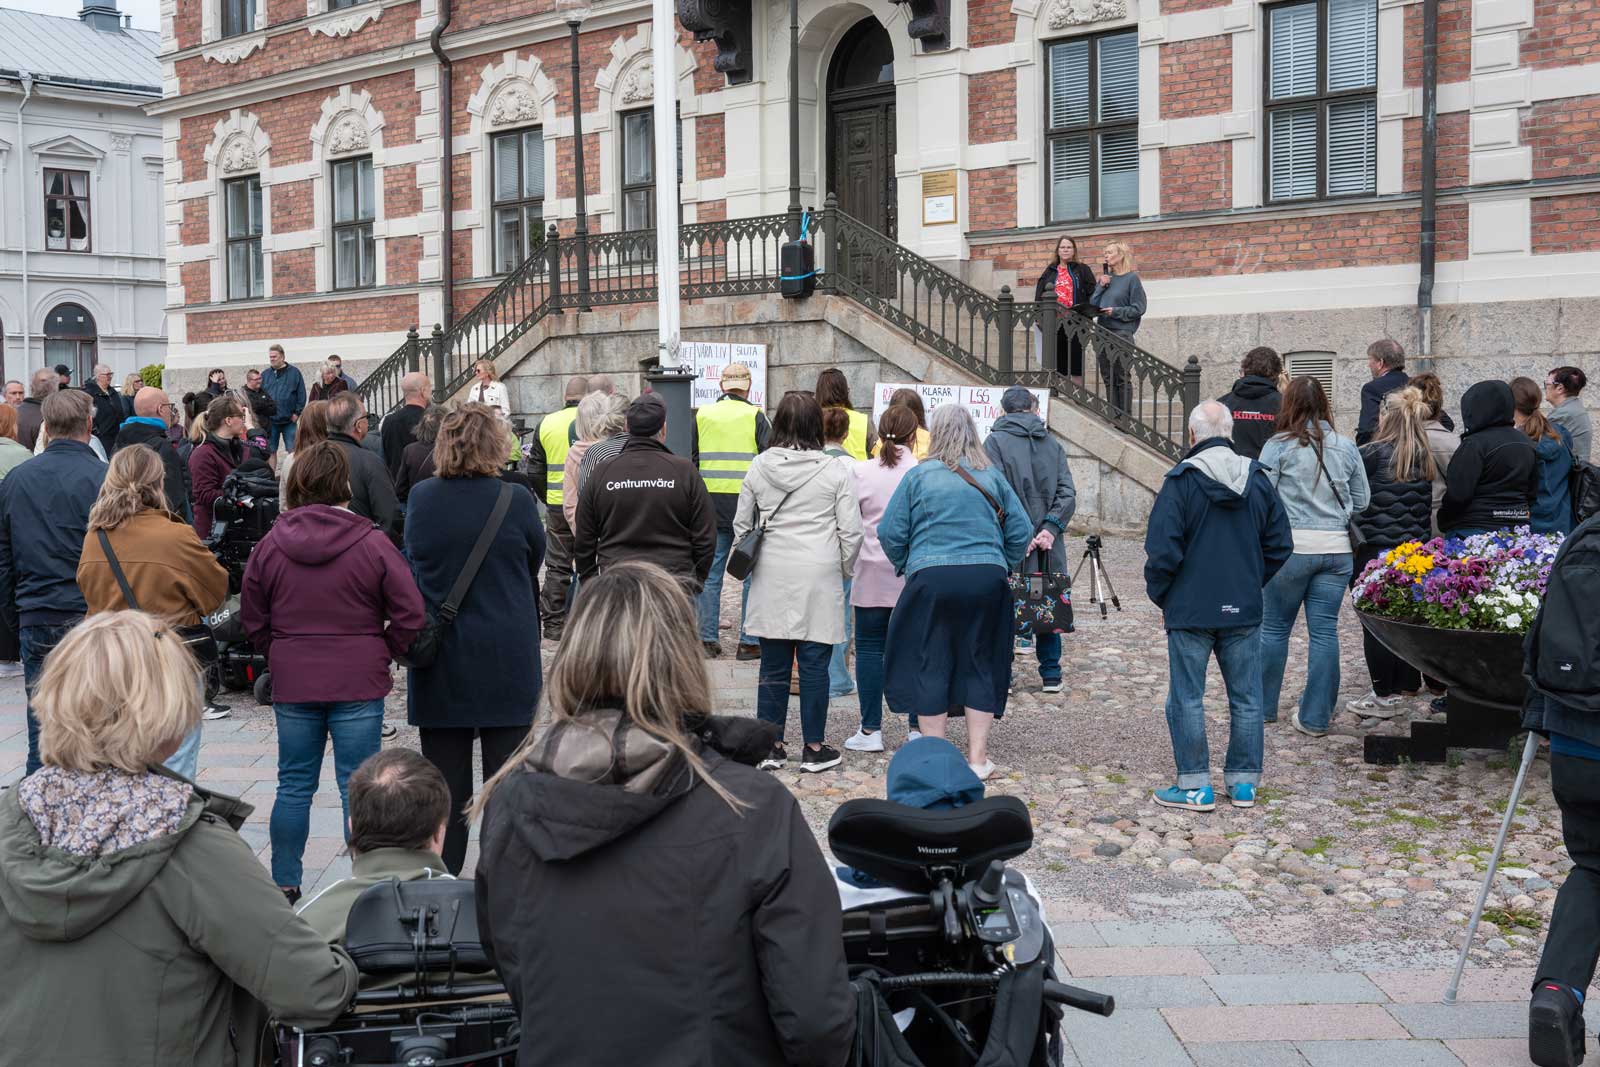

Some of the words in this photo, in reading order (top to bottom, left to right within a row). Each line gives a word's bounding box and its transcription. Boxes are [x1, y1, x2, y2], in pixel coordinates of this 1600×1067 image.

[922, 386, 953, 397] KLARAR
[969, 388, 990, 403] LSS
[606, 478, 675, 491] Centrumvärd
